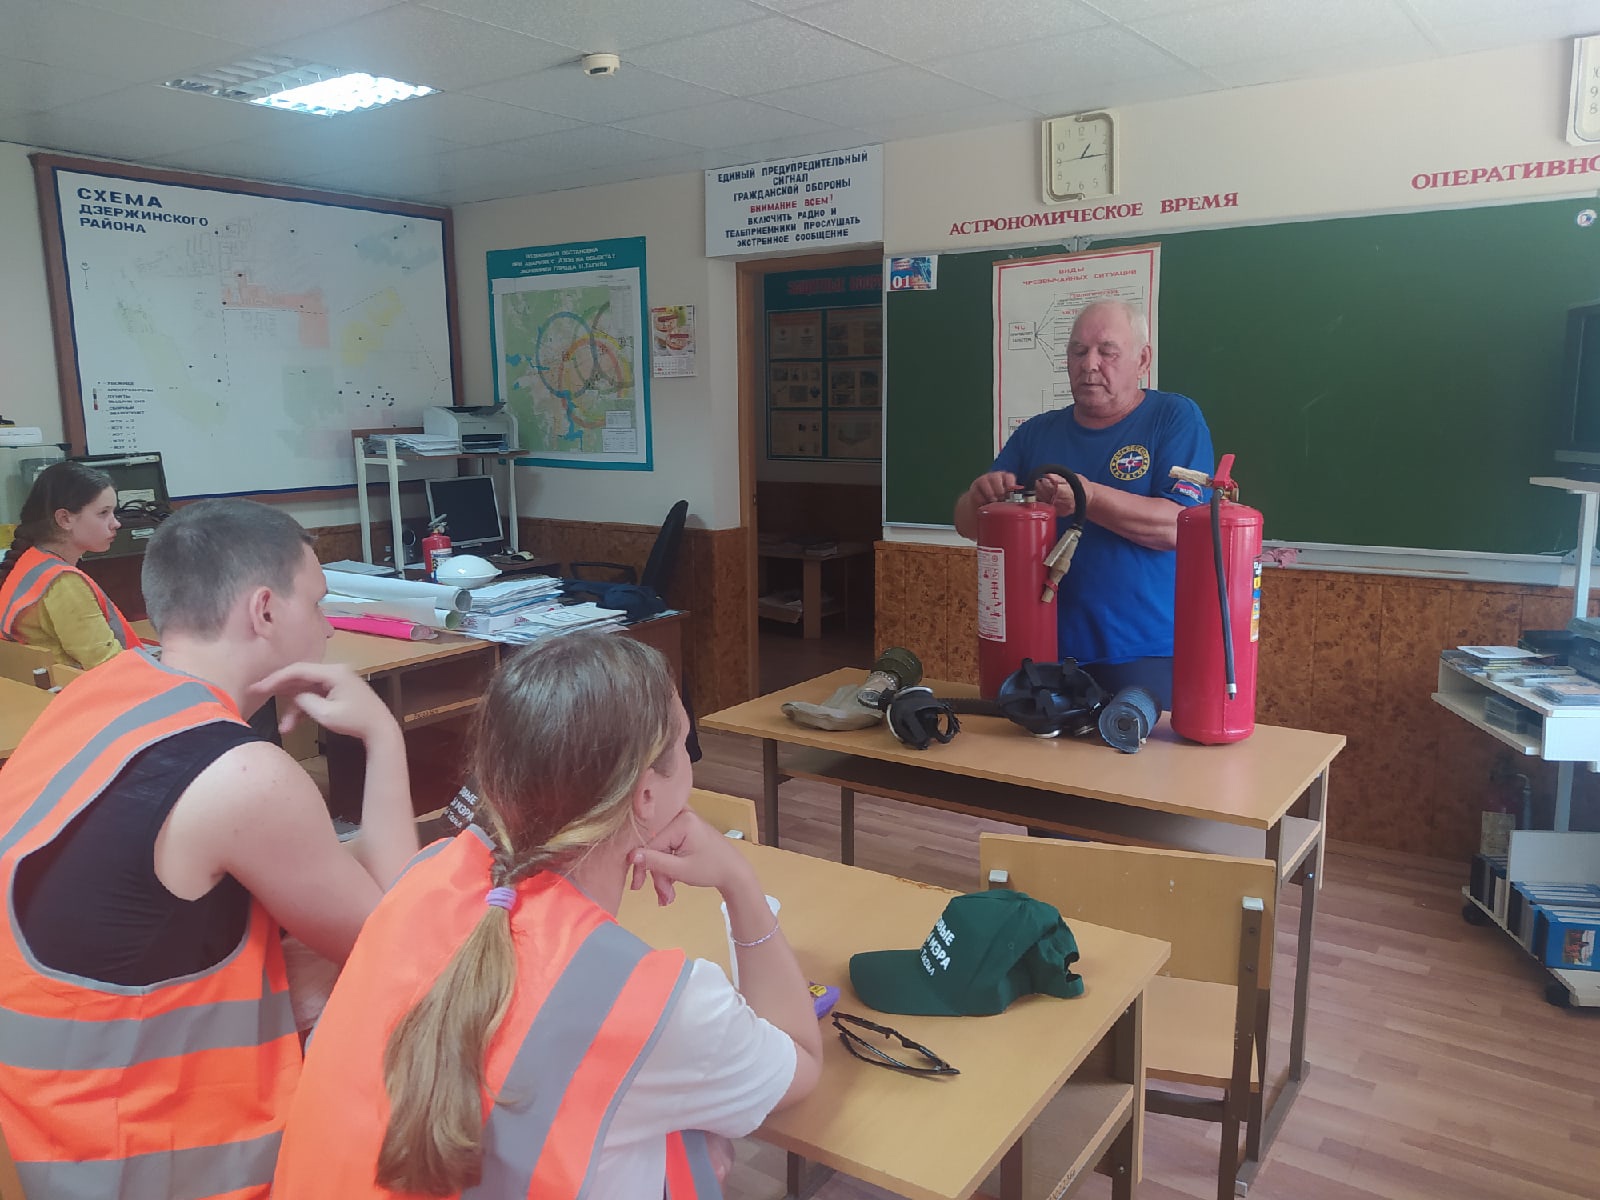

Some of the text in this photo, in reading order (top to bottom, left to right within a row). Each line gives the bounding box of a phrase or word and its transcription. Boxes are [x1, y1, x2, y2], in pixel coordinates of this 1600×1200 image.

[718, 152, 868, 183] ЕДИНЫЙ ПРЕДУПРЕДИТЕЛЬНЫЙ
[773, 173, 808, 186] СИГНАЛ
[77, 187, 163, 208] СХЕМА
[734, 178, 851, 201] ГРАЖДАНСКОЙ ОБОРОНЫ
[750, 194, 834, 213] ВНИМАНИЕ ВСЕМ!
[79, 204, 209, 227] ДЗЕРЖИНСКОГО
[747, 212, 793, 225] ВКЛЮЧИТЬ
[797, 209, 825, 220] РАДИО
[949, 192, 1239, 236] АСТРОНОМИЧЕСКОЕ ВРЕМЯ
[80, 217, 147, 233] РАЙОНА
[725, 216, 861, 238] ТЕЛЕПРИЕМНИКИ ПРОСЛУШАТЬ
[737, 228, 849, 247] ЭКСТРЕННОЕ СООБЩЕНИЕ
[1022, 274, 1088, 286] ЧРЕЗВЫЧАЙНЫХ
[1058, 267, 1085, 275] ВИДЫ
[892, 275, 911, 289] 01
